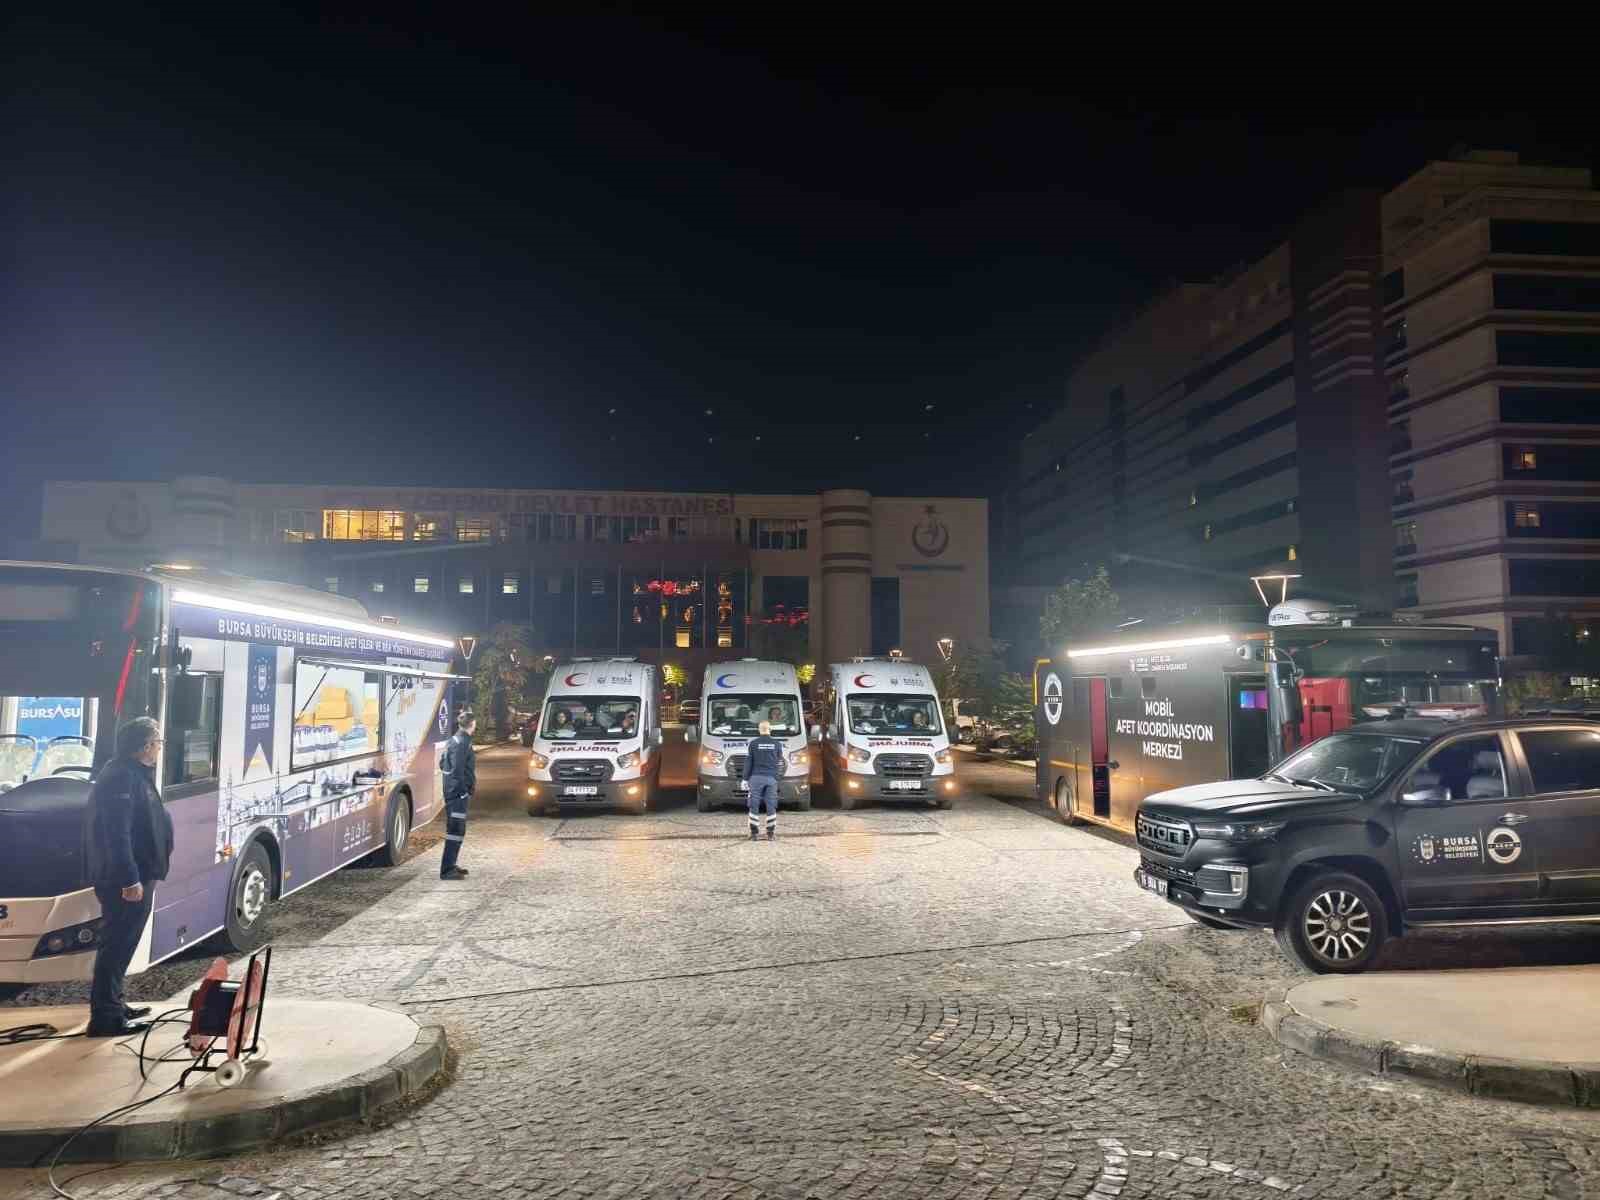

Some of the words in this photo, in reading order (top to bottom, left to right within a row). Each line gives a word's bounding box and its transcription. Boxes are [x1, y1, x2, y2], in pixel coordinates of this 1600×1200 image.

[217, 618, 252, 637] BURSA
[254, 621, 304, 645] BÜYÜKŞEHİR
[20, 704, 81, 719] BURSASU
[1144, 697, 1175, 717] MOBİL
[1116, 719, 1136, 734] AFET
[1137, 719, 1214, 742] KOORDİNASYON
[1142, 741, 1183, 760] MERKEZİ
[1138, 820, 1185, 845] FOTON
[1443, 836, 1478, 846] BURSA
